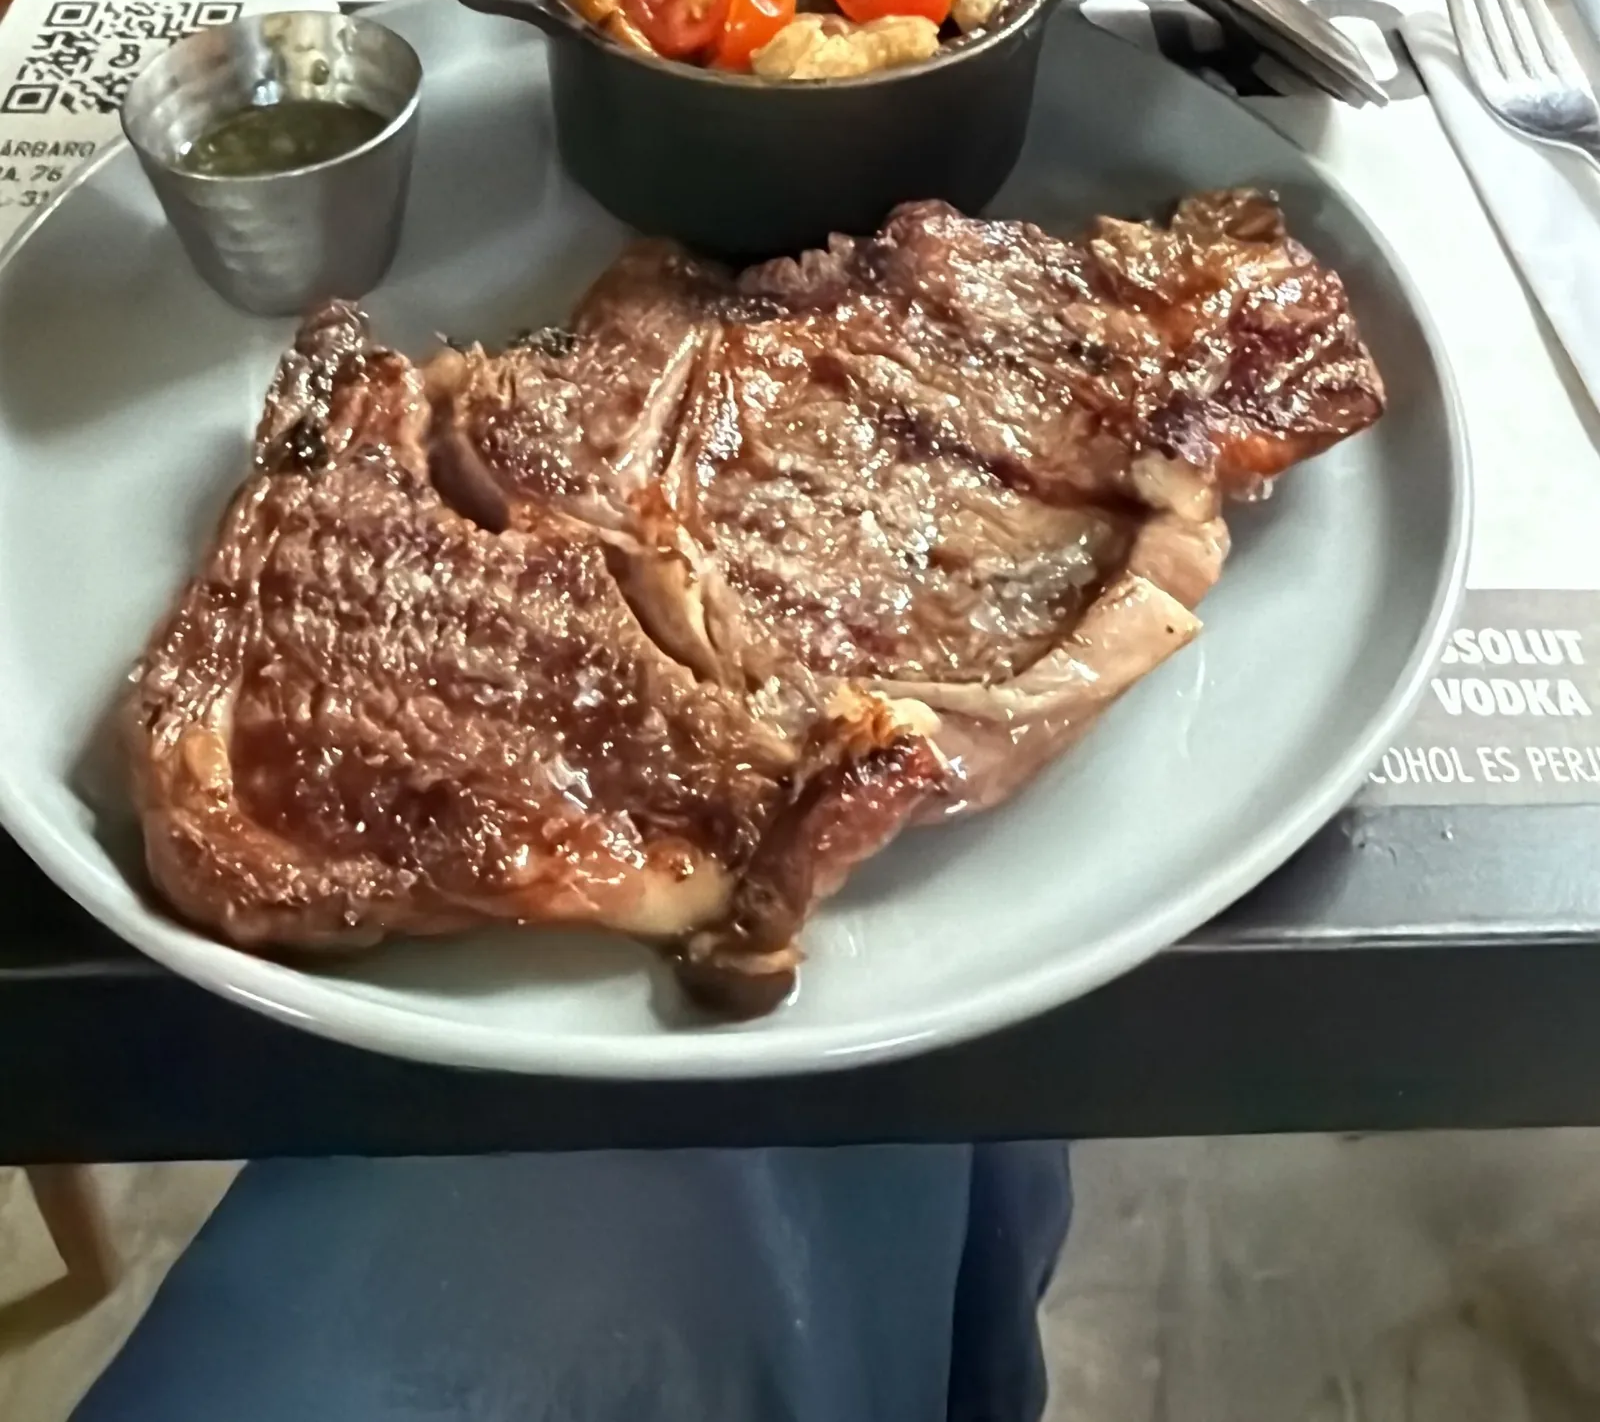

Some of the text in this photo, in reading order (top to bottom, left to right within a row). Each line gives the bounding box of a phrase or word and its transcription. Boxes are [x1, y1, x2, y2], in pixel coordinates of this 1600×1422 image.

[29, 164, 65, 183] 76
[1430, 677, 1593, 717] VODKA
[1476, 746, 1520, 783] ES
[1525, 746, 1600, 783] PERJ
